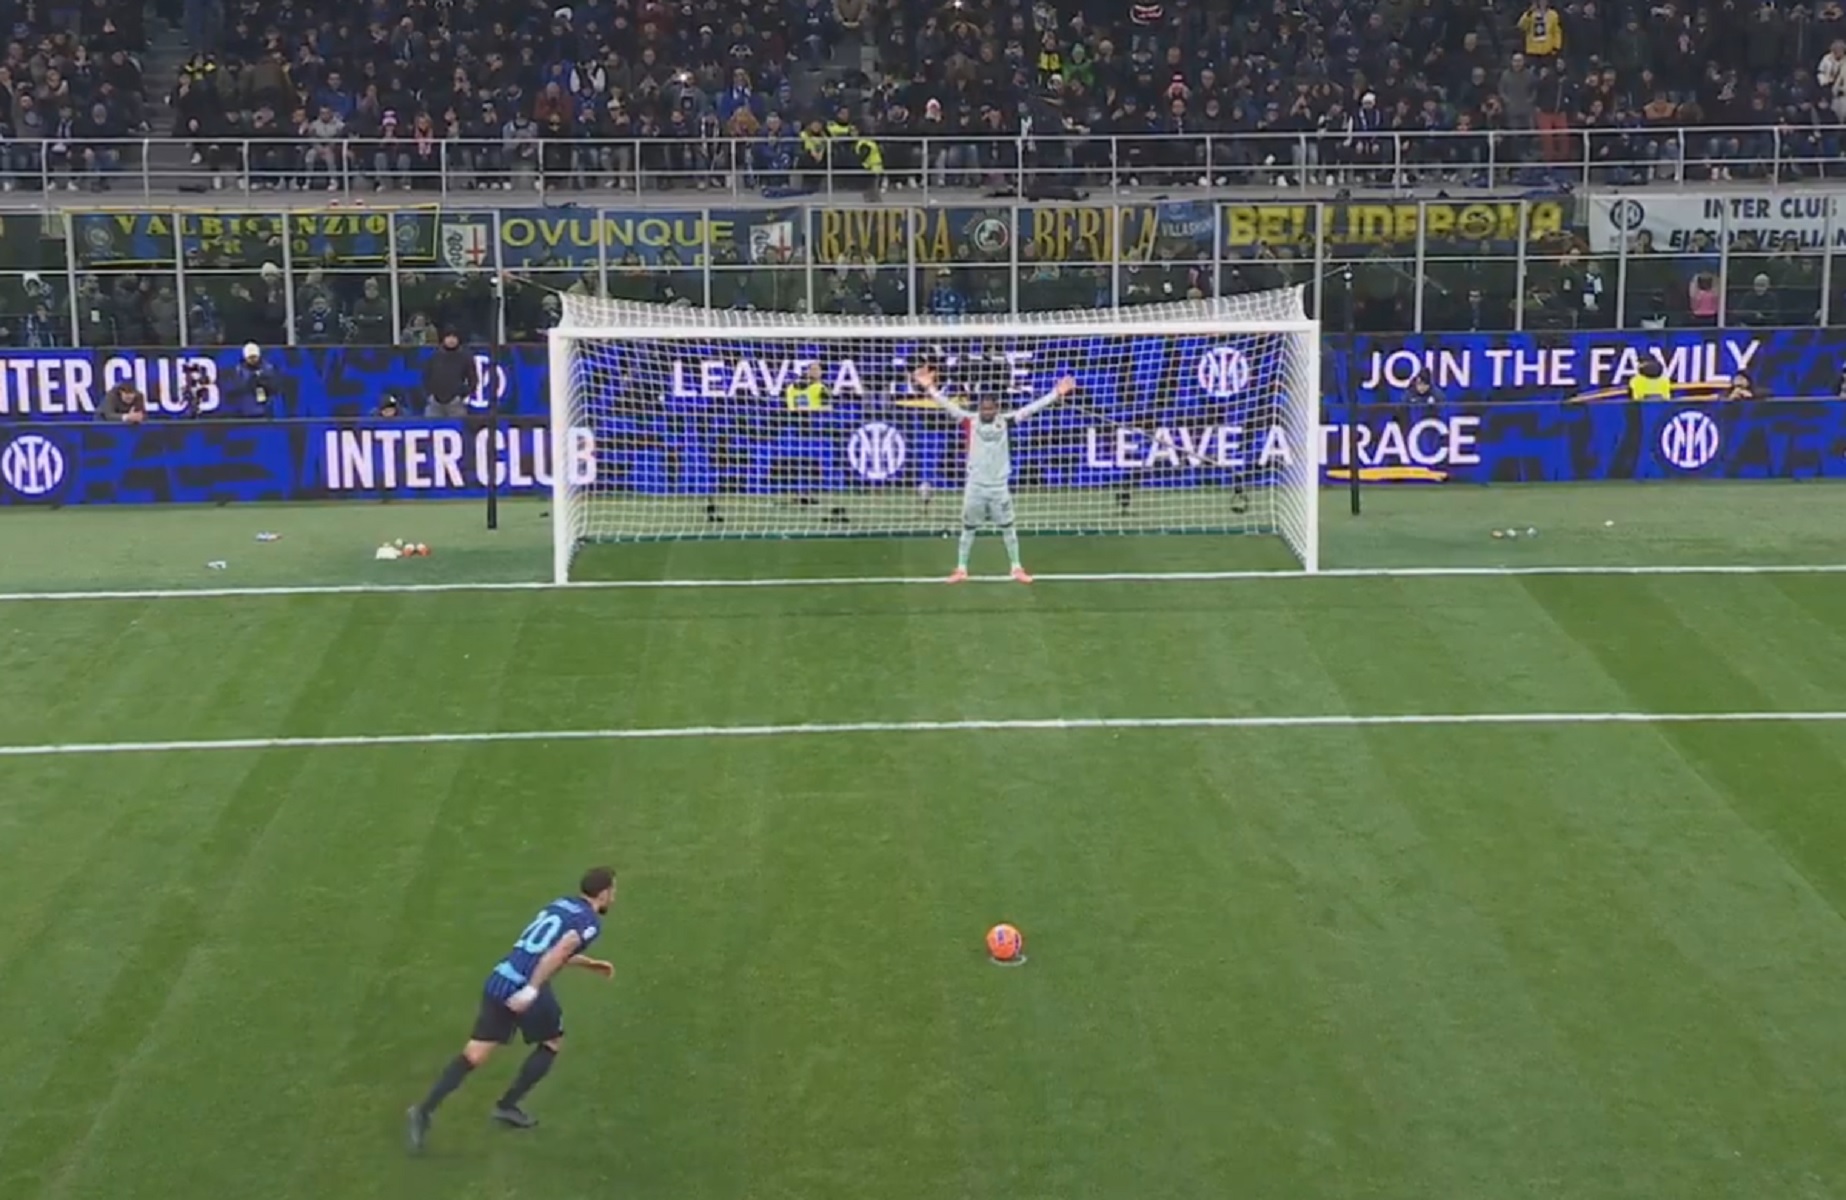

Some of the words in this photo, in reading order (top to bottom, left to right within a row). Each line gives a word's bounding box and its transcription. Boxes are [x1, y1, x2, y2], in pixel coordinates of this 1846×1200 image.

[501, 217, 734, 248] OVUNQUE
[1703, 198, 1770, 219] INTER
[1780, 196, 1837, 219] CLUB
[821, 207, 953, 264] RIVIERA
[0, 358, 95, 413] TER
[104, 357, 220, 413] CLUB
[832, 359, 864, 395] A
[1362, 350, 1470, 389] JOIN
[1485, 349, 1576, 387] THE
[1589, 340, 1760, 385] FAMILY
[325, 429, 465, 489] INTER
[475, 426, 597, 487] CLUB
[1086, 426, 1245, 468] LEAVE
[1257, 425, 1295, 466] A
[1319, 416, 1481, 465] TRACE
